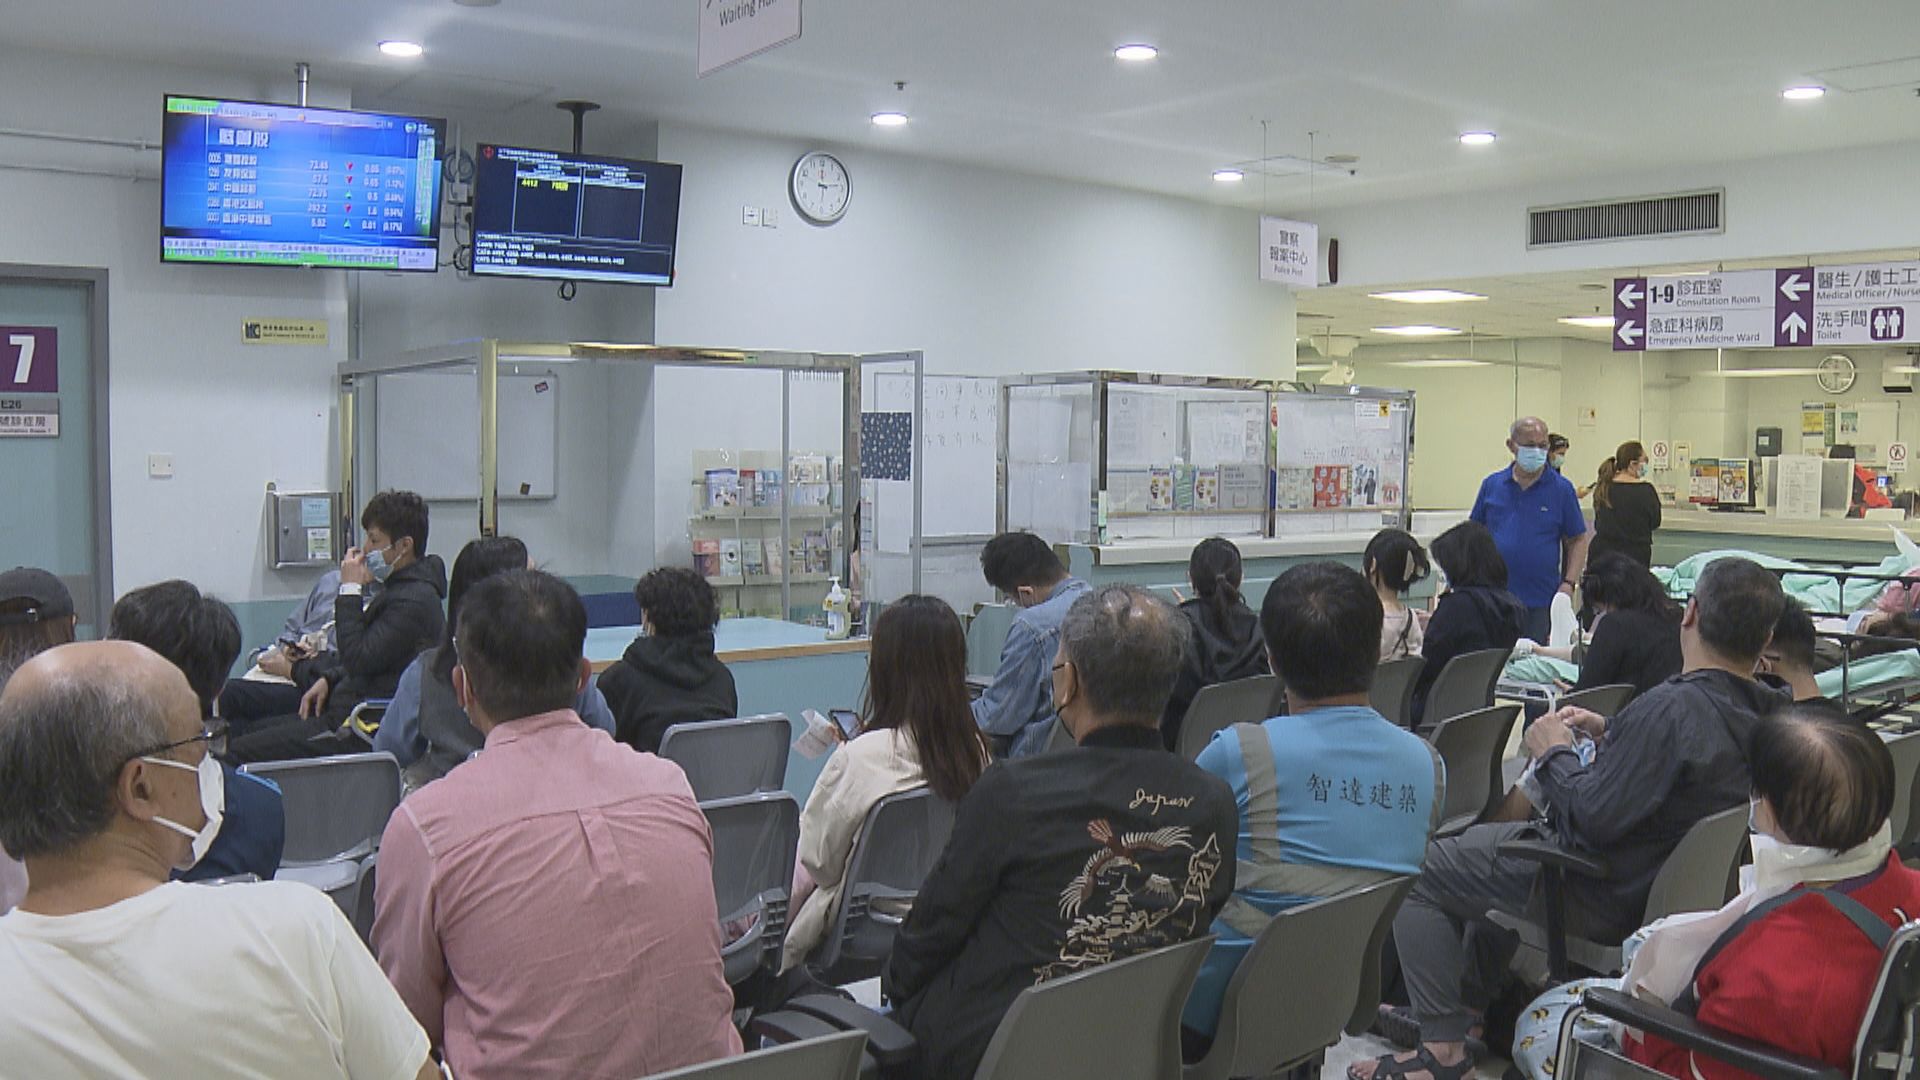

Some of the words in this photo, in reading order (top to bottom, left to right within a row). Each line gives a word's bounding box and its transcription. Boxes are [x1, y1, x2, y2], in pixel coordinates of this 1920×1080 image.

[719, 1, 756, 26] Waiting
[758, 0, 778, 9] Ha
[1279, 230, 1299, 247] 警察
[1270, 246, 1308, 265] 報案中心
[1677, 278, 1722, 296] 診症室
[1817, 267, 1920, 289] 醫生/護士工
[1650, 284, 1674, 304] 1-9
[1676, 297, 1729, 307] Consultation
[1731, 296, 1760, 304] Rooms
[1817, 290, 1852, 300] Medical
[1649, 316, 1724, 333] 急症科病房
[1817, 309, 1867, 328] 洗手間
[1649, 334, 1693, 345] Emergency
[1695, 333, 1734, 343] Medicine
[1736, 332, 1760, 342] Ward
[1817, 330, 1842, 339] Toilet
[9, 335, 35, 384] 7
[1129, 787, 1194, 815] Japan
[1306, 772, 1417, 814] 智達建築
